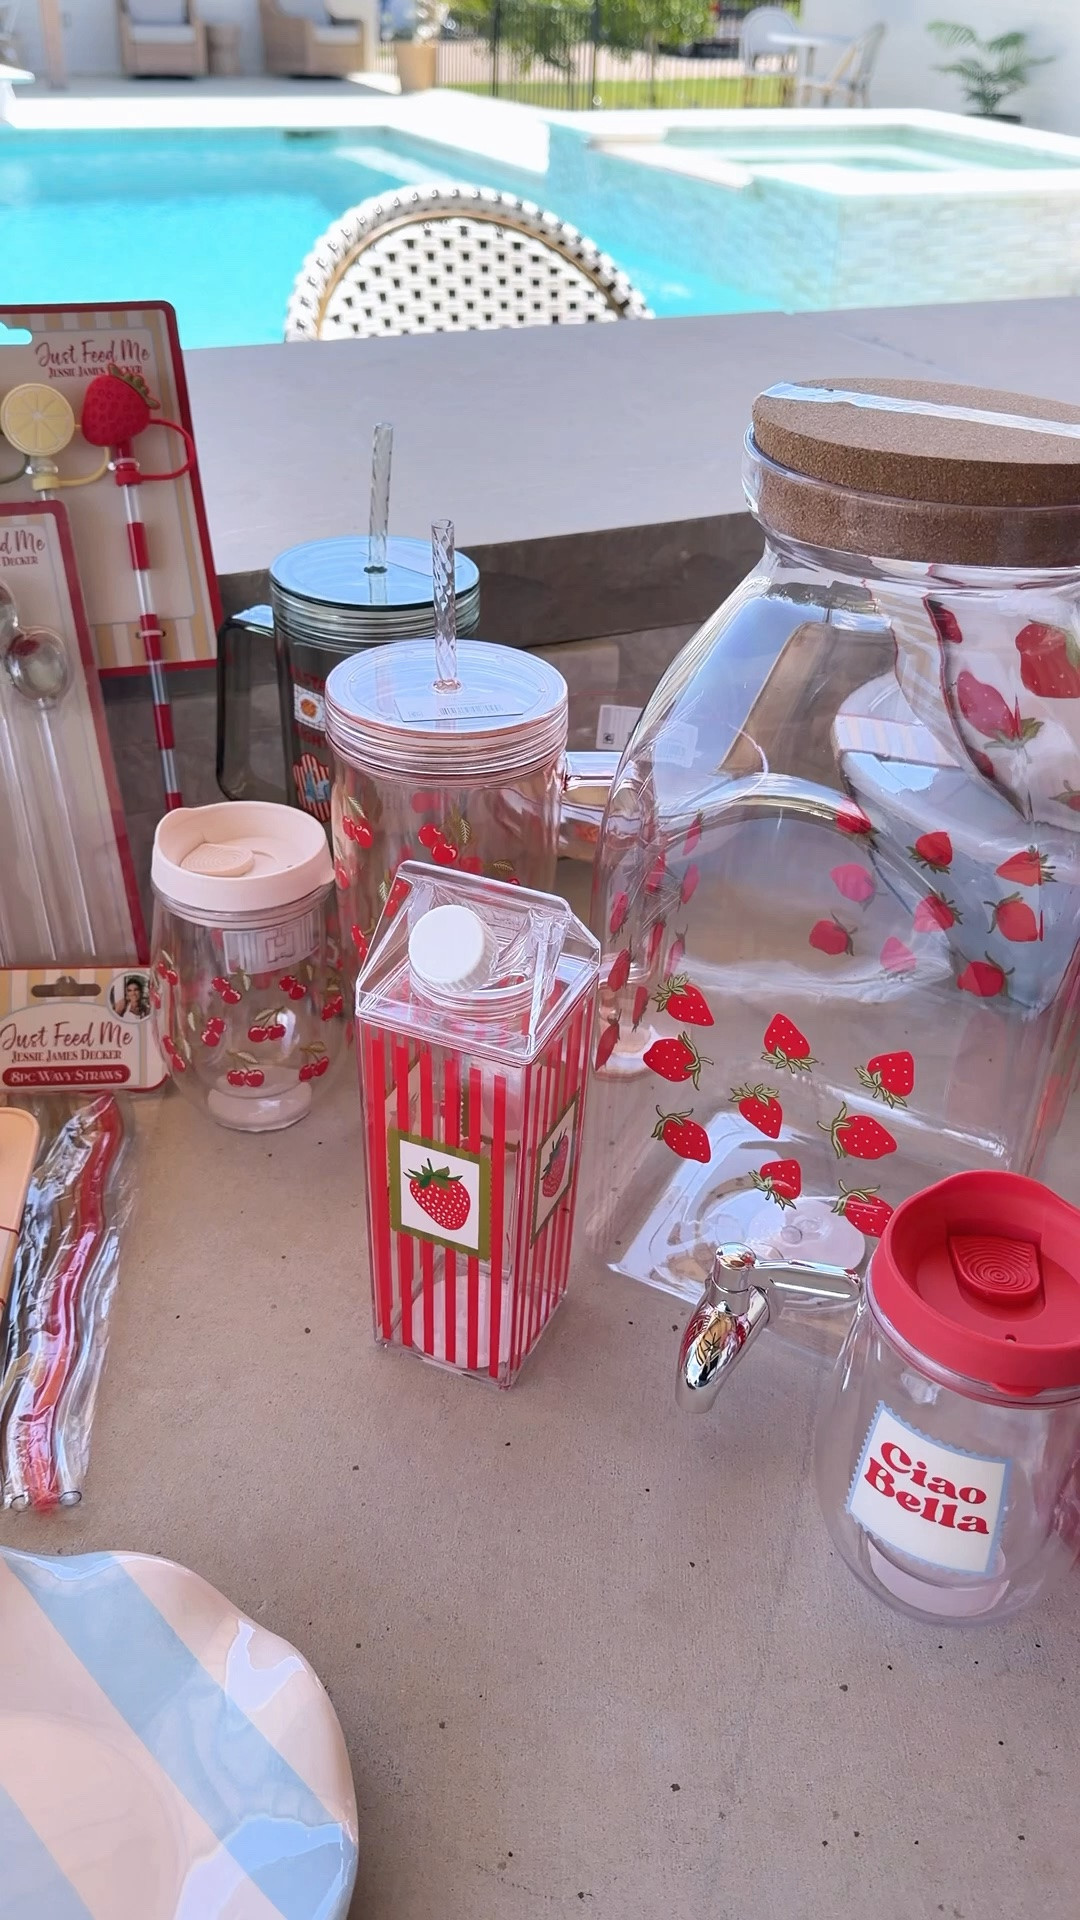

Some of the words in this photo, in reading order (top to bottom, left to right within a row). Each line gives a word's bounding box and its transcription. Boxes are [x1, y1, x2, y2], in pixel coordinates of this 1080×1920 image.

[35, 341, 77, 367] Just
[81, 340, 116, 363] Feed
[121, 339, 150, 362] Me
[49, 367, 76, 378] JESSIE
[79, 366, 105, 377] JAMES
[15, 529, 45, 553] Me
[2, 556, 39, 567] DECKER
[0, 1023, 48, 1050] Just
[54, 1021, 94, 1047] Feed
[100, 1021, 133, 1048] Me
[12, 1051, 44, 1063] JESSIE
[46, 1050, 78, 1062] JAMES
[81, 1049, 122, 1061] DECKER
[10, 1071, 37, 1083] 8PC
[38, 1070, 73, 1082] WAVY
[75, 1069, 122, 1081] STRAWS
[880, 1442, 987, 1504] Ciao
[864, 1457, 989, 1534] Bella
